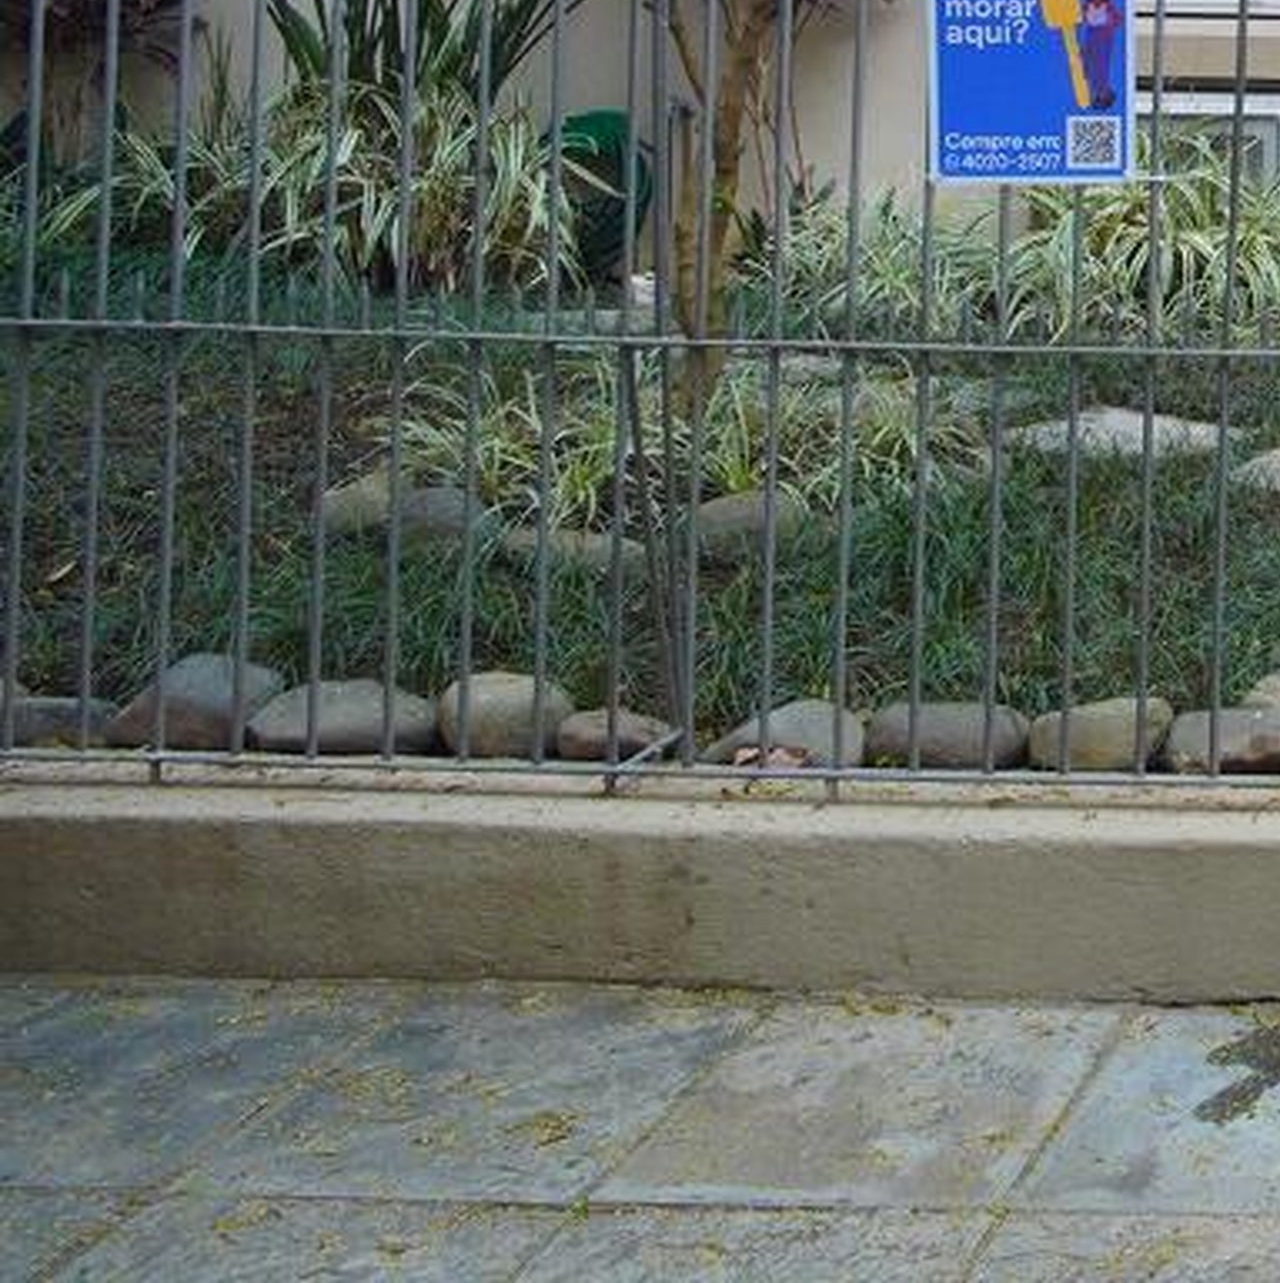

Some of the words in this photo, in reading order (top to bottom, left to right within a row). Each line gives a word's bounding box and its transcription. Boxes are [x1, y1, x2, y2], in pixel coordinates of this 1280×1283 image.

[944, 0, 1037, 18] morar
[946, 19, 1030, 49] aqui?
[944, 132, 1023, 152] Compre
